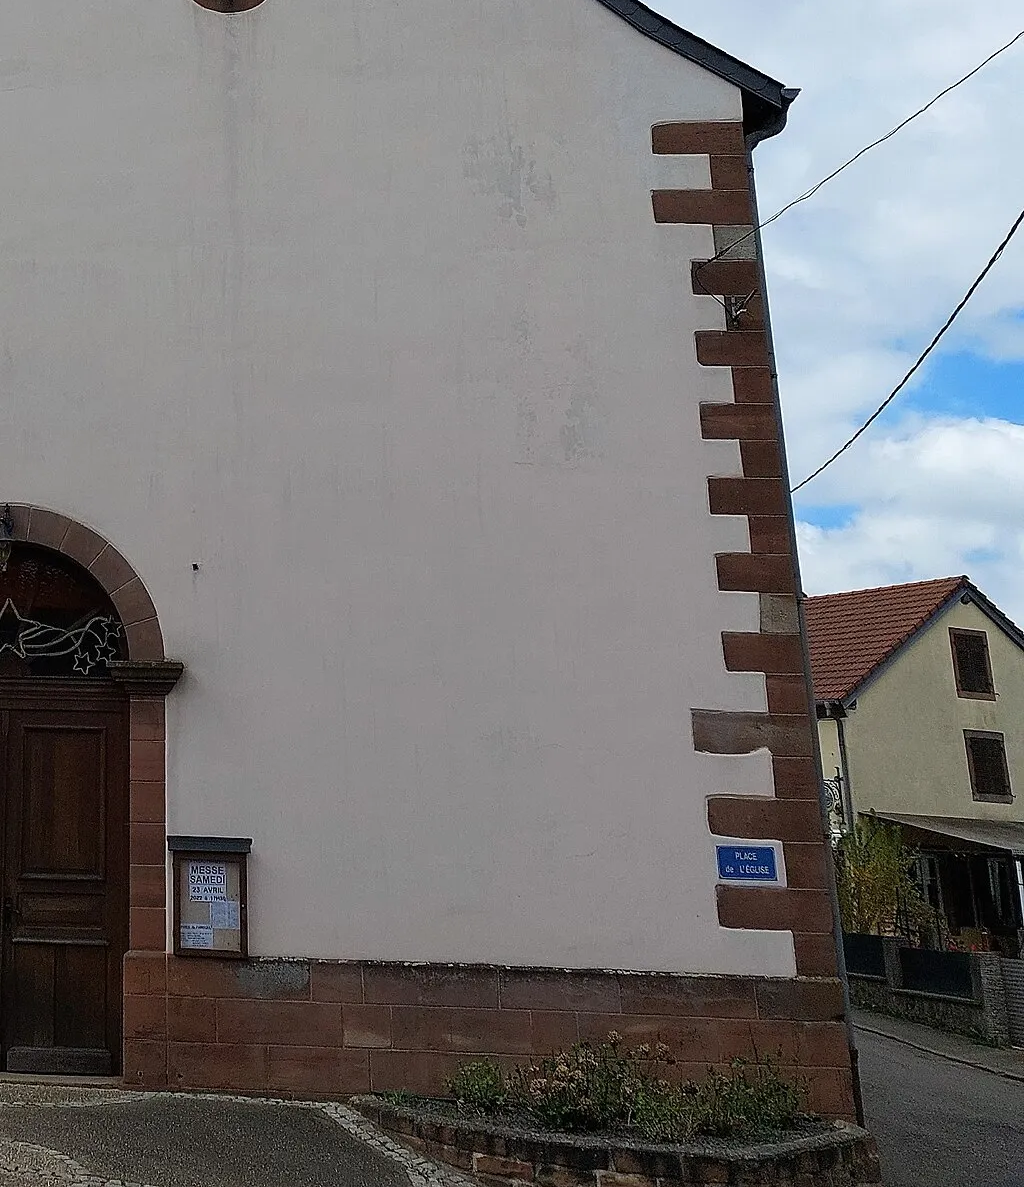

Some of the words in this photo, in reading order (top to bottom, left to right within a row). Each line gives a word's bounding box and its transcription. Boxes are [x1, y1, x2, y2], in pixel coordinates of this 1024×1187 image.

[735, 852, 758, 861] PLACE
[191, 865, 224, 874] MESSE
[725, 865, 734, 873] de
[739, 864, 770, 874] L'ÉGLISE
[190, 875, 225, 884] SAMEDI
[203, 886, 223, 894] AVRIL
